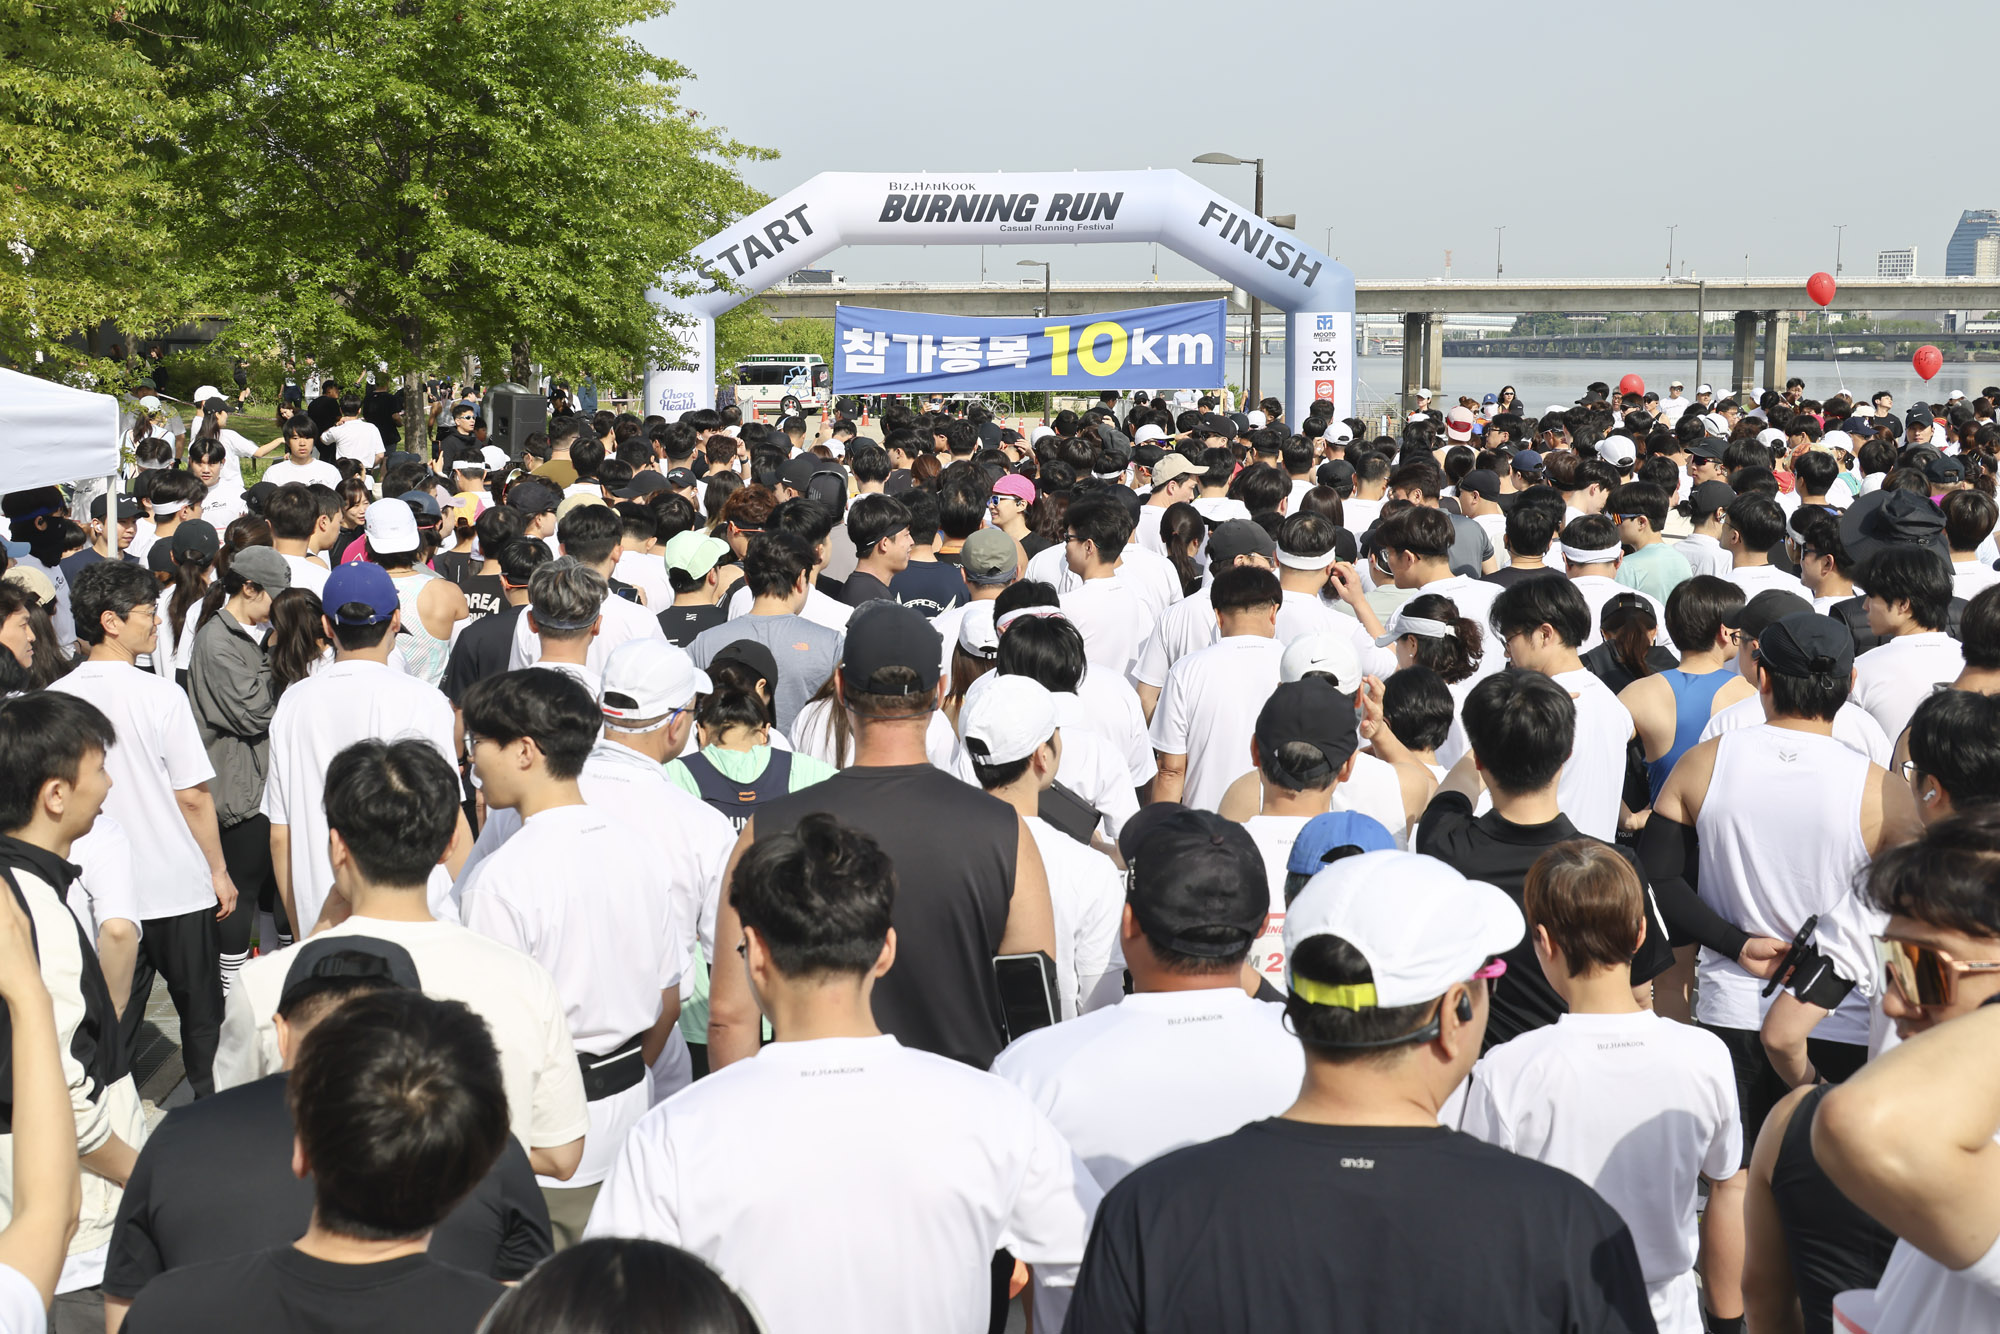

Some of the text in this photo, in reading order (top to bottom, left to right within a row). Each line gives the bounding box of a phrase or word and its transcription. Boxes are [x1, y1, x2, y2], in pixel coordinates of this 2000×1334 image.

[878, 192, 1125, 223] BURNING RUN
[999, 222, 1115, 233] Casual Running Festival
[697, 203, 813, 293] START
[1198, 200, 1322, 288] FINISH
[841, 327, 1031, 374] 참가종목
[662, 388, 695, 400] Choco
[659, 399, 697, 412] Health
[1340, 1156, 1375, 1170] andar
